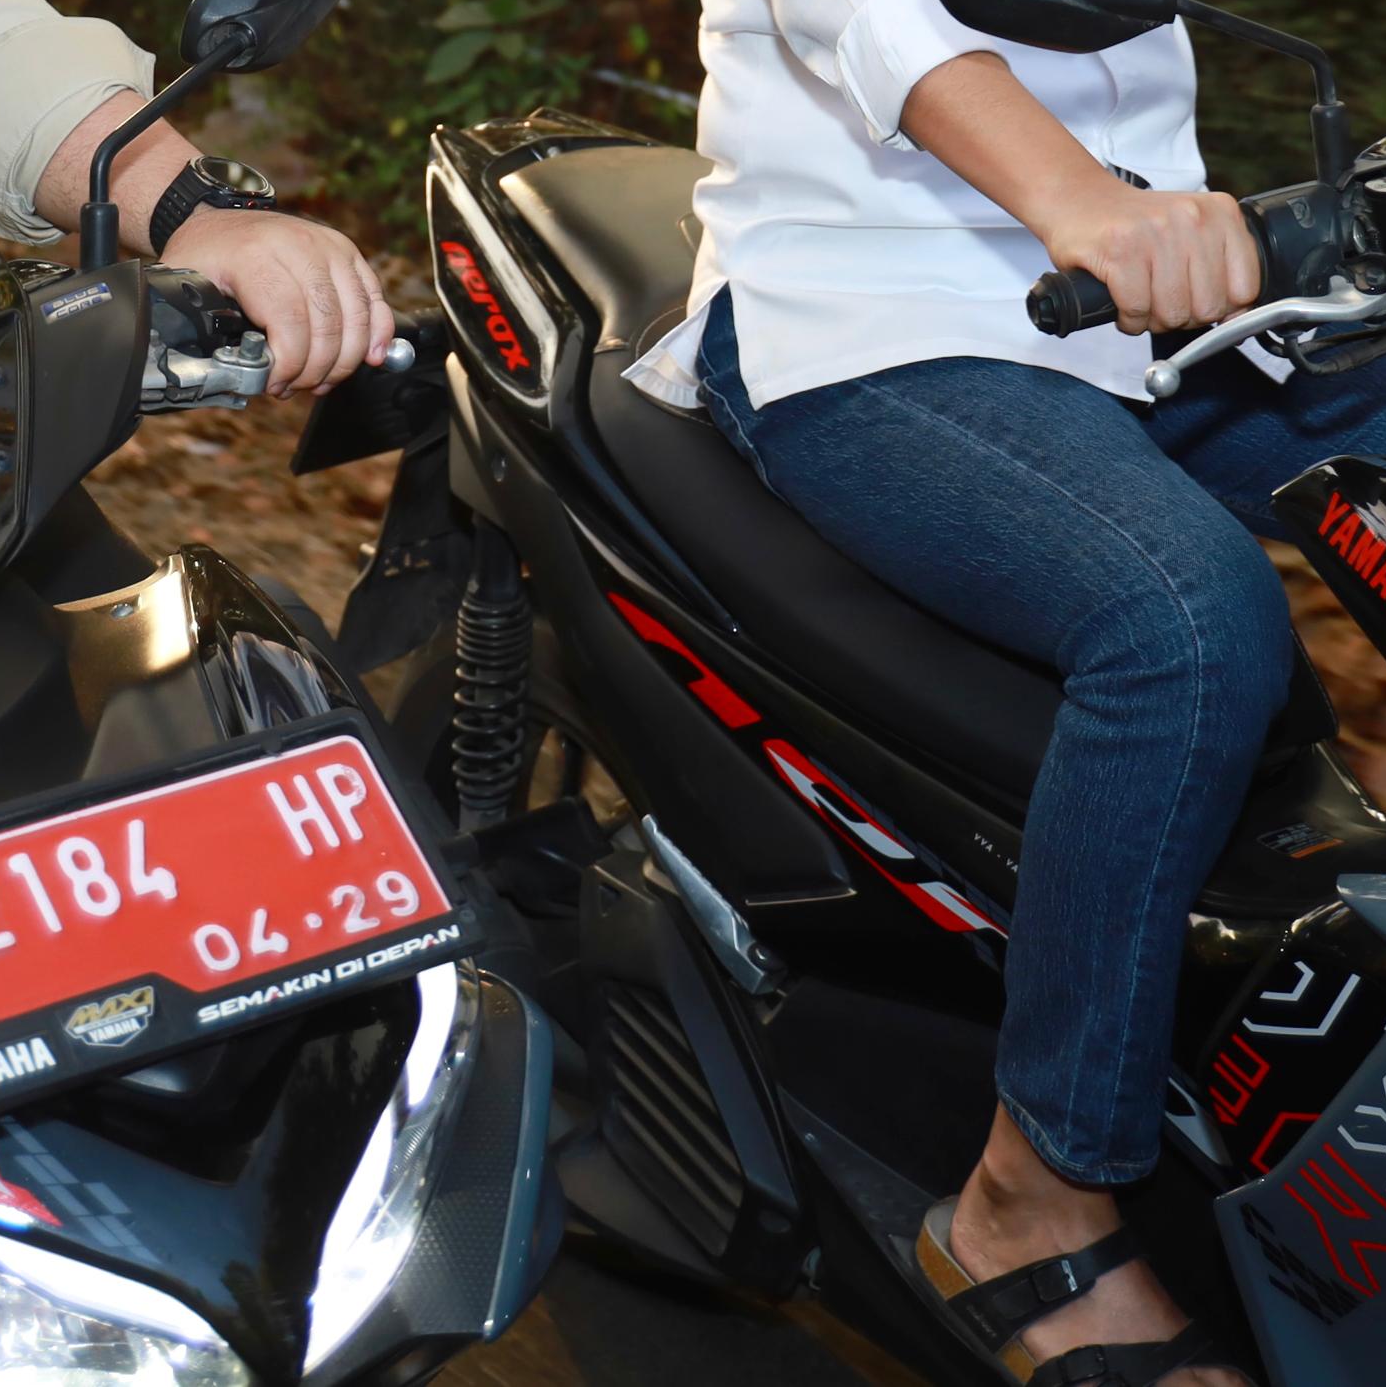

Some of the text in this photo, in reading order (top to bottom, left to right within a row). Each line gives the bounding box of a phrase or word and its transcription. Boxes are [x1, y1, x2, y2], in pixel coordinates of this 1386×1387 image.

[265, 763, 367, 857] HP
[974, 833, 993, 852] VVA
[366, 925, 460, 968] DEPAN
[88, 1017, 141, 1043] YAMAHA
